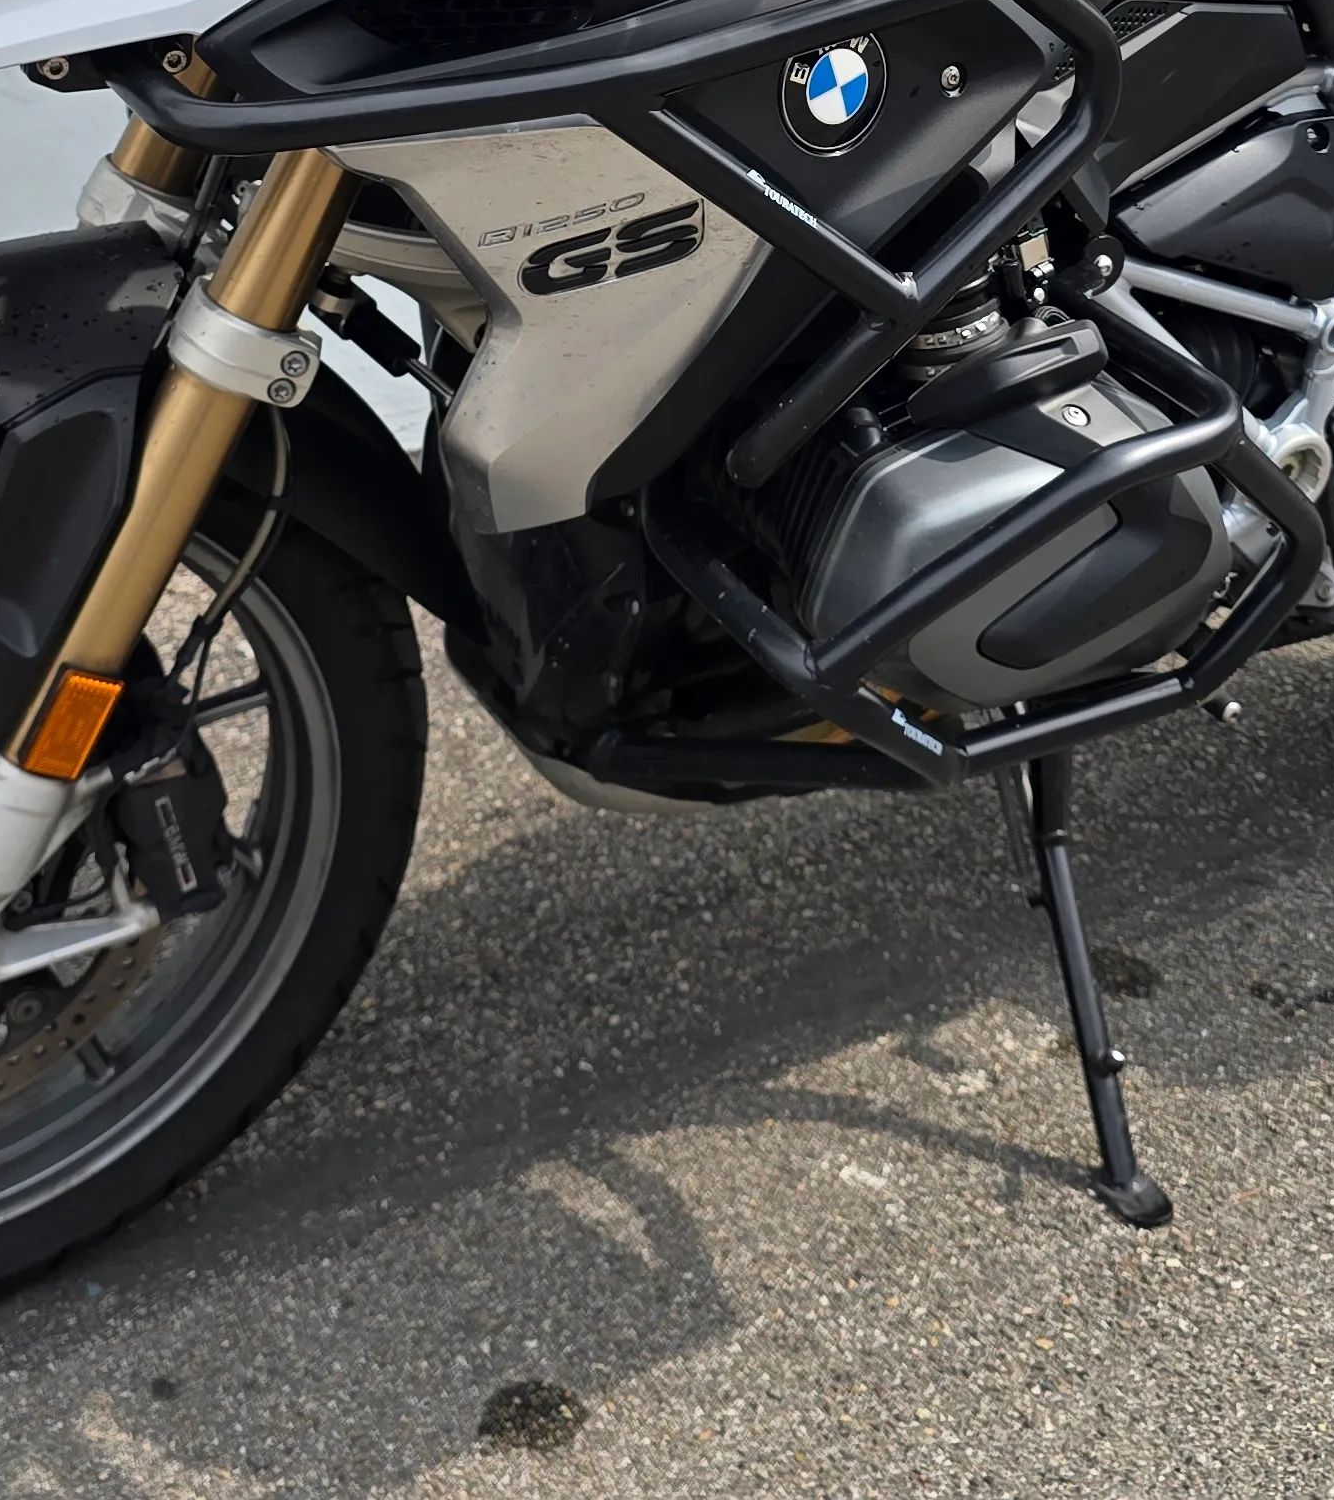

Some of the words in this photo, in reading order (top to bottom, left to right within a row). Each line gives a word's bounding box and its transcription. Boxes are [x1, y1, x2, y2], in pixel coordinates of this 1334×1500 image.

[789, 35, 870, 85] BW
[477, 192, 646, 248] R1250
[763, 183, 818, 229] TOURATECH
[520, 200, 701, 296] GS
